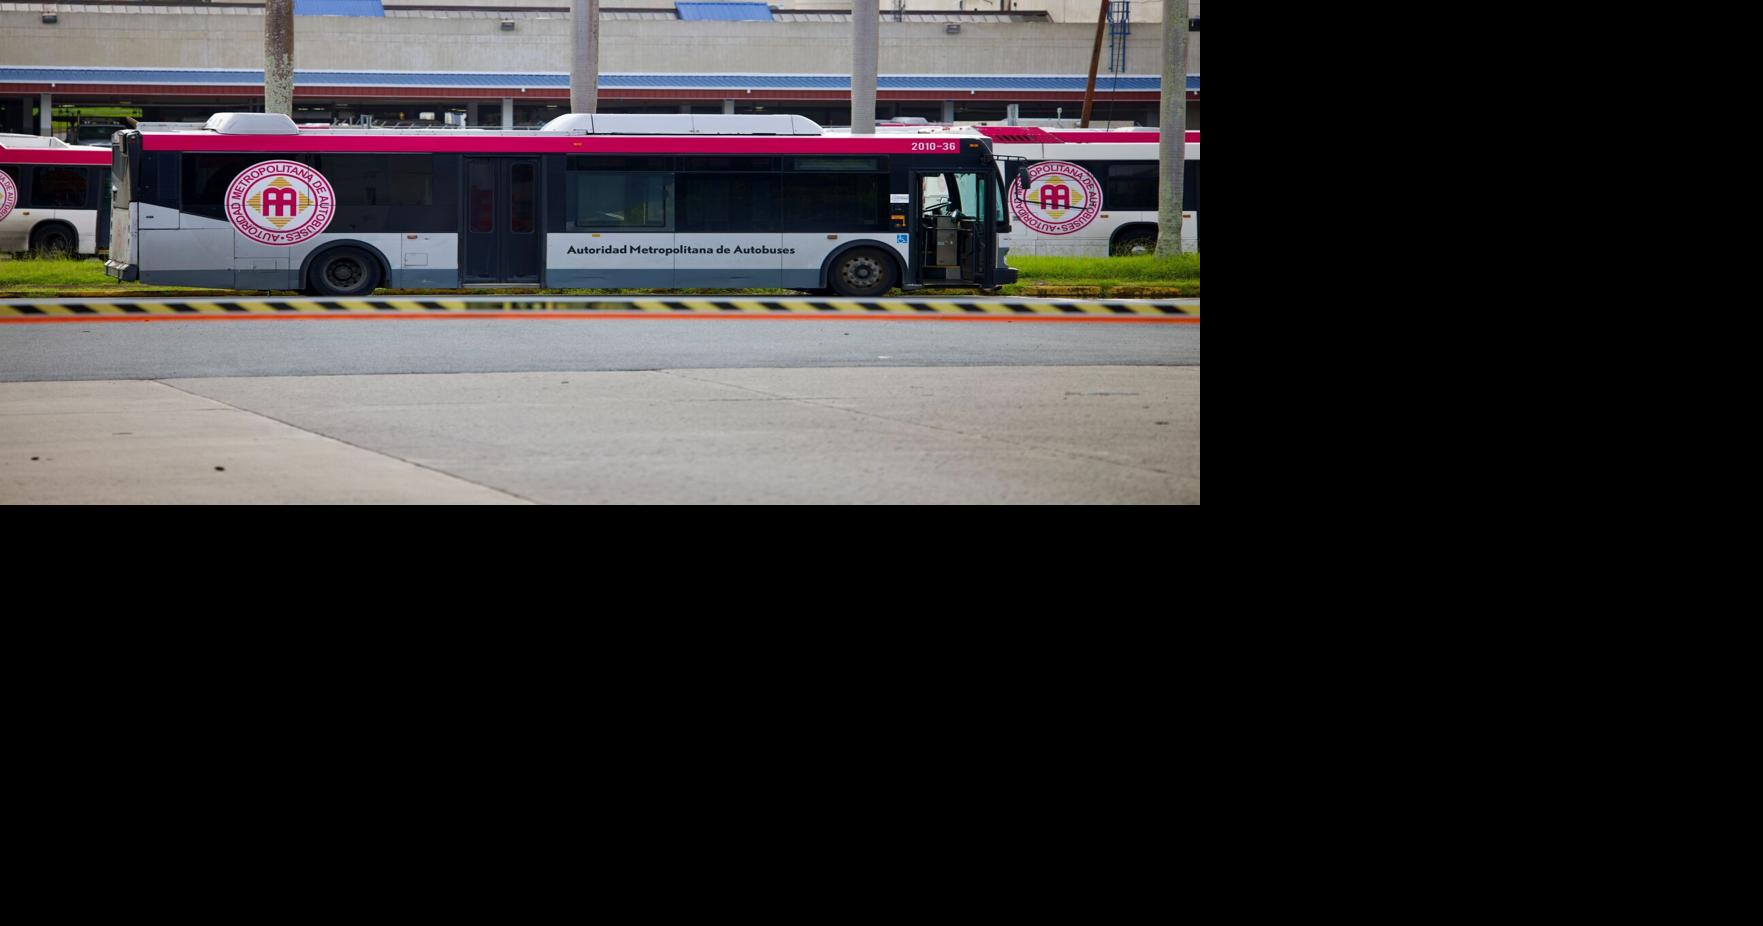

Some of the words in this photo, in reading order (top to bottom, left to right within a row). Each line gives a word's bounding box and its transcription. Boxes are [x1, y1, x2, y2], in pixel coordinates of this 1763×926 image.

[911, 142, 956, 151] 2010-36
[232, 164, 314, 199] METROPOLITANA
[312, 180, 326, 195] DE
[1082, 178, 1095, 190] DE
[231, 203, 280, 242] AUTORIDAD
[285, 194, 329, 242] AUTOBUSES
[1061, 191, 1098, 232] AUTOBUSES
[566, 244, 627, 255] Autoridad
[629, 244, 714, 257] Metropolitana
[716, 244, 731, 255] de
[733, 244, 796, 255] Autobuses
